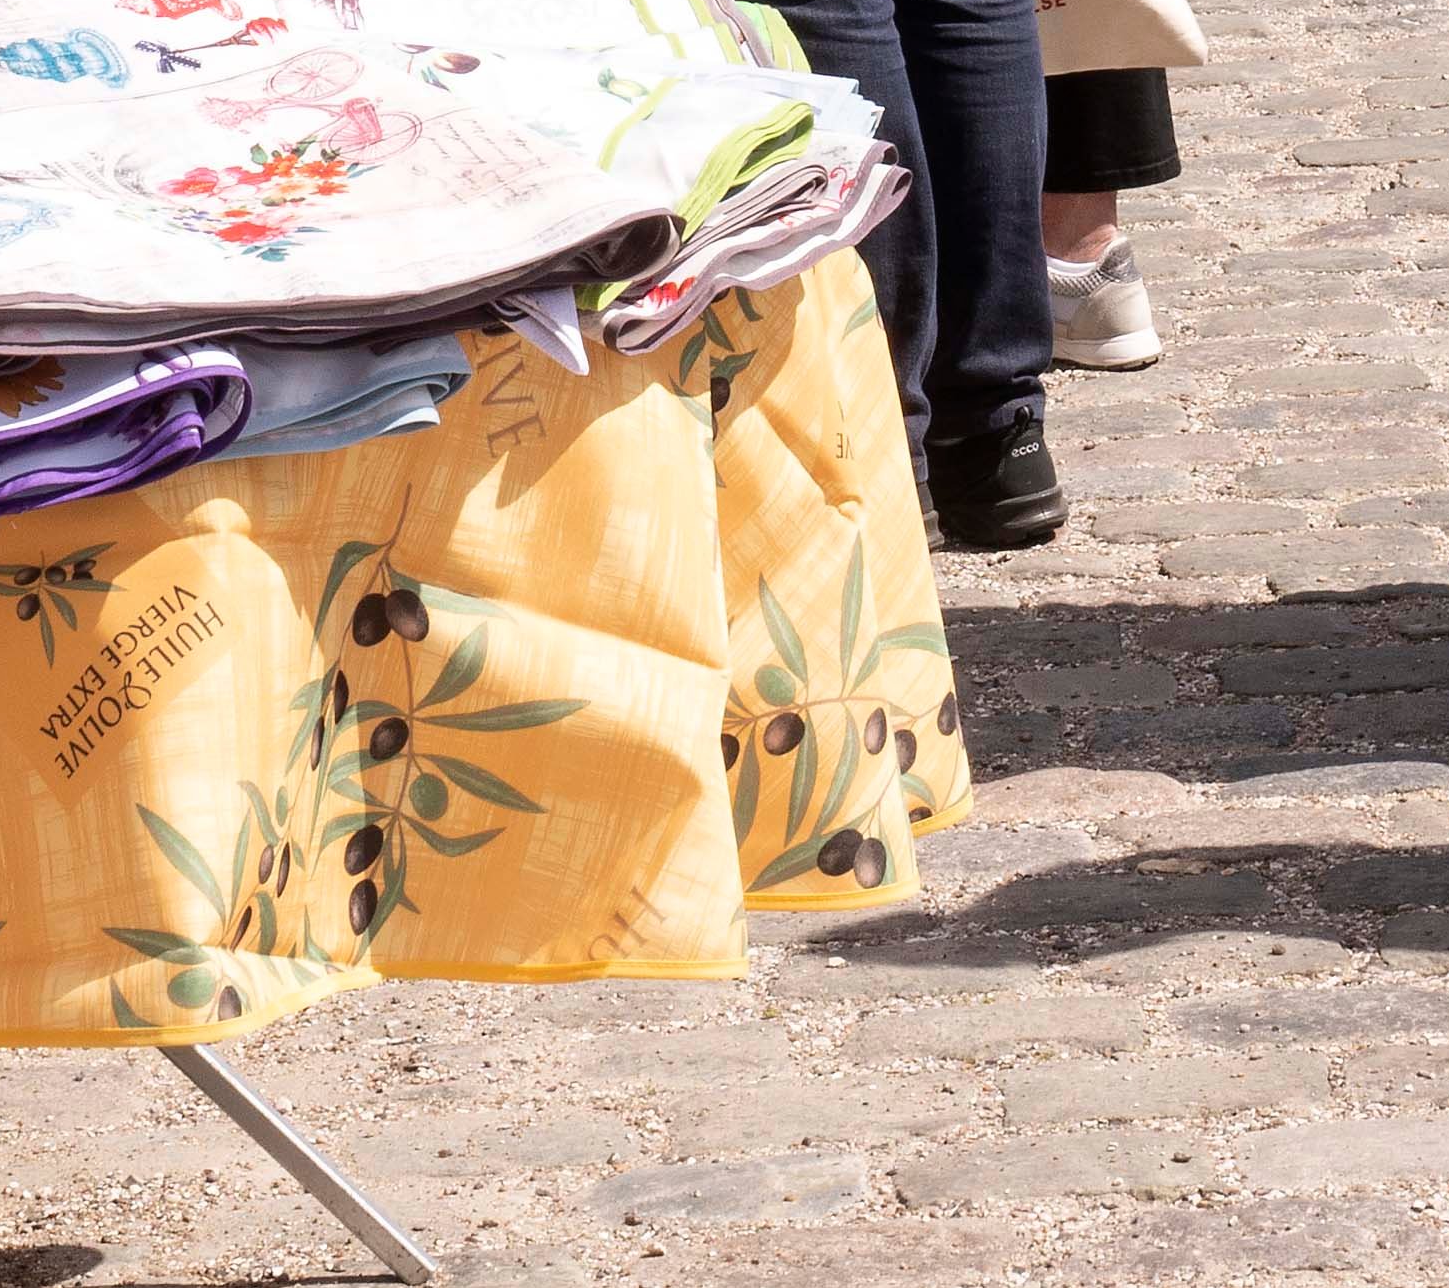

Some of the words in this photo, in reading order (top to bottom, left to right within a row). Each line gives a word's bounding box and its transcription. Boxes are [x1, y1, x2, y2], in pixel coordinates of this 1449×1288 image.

[1011, 441, 1040, 458] ecco
[100, 584, 199, 670] VIERGE
[136, 599, 225, 684] HUILE
[39, 664, 107, 741] EXTRA
